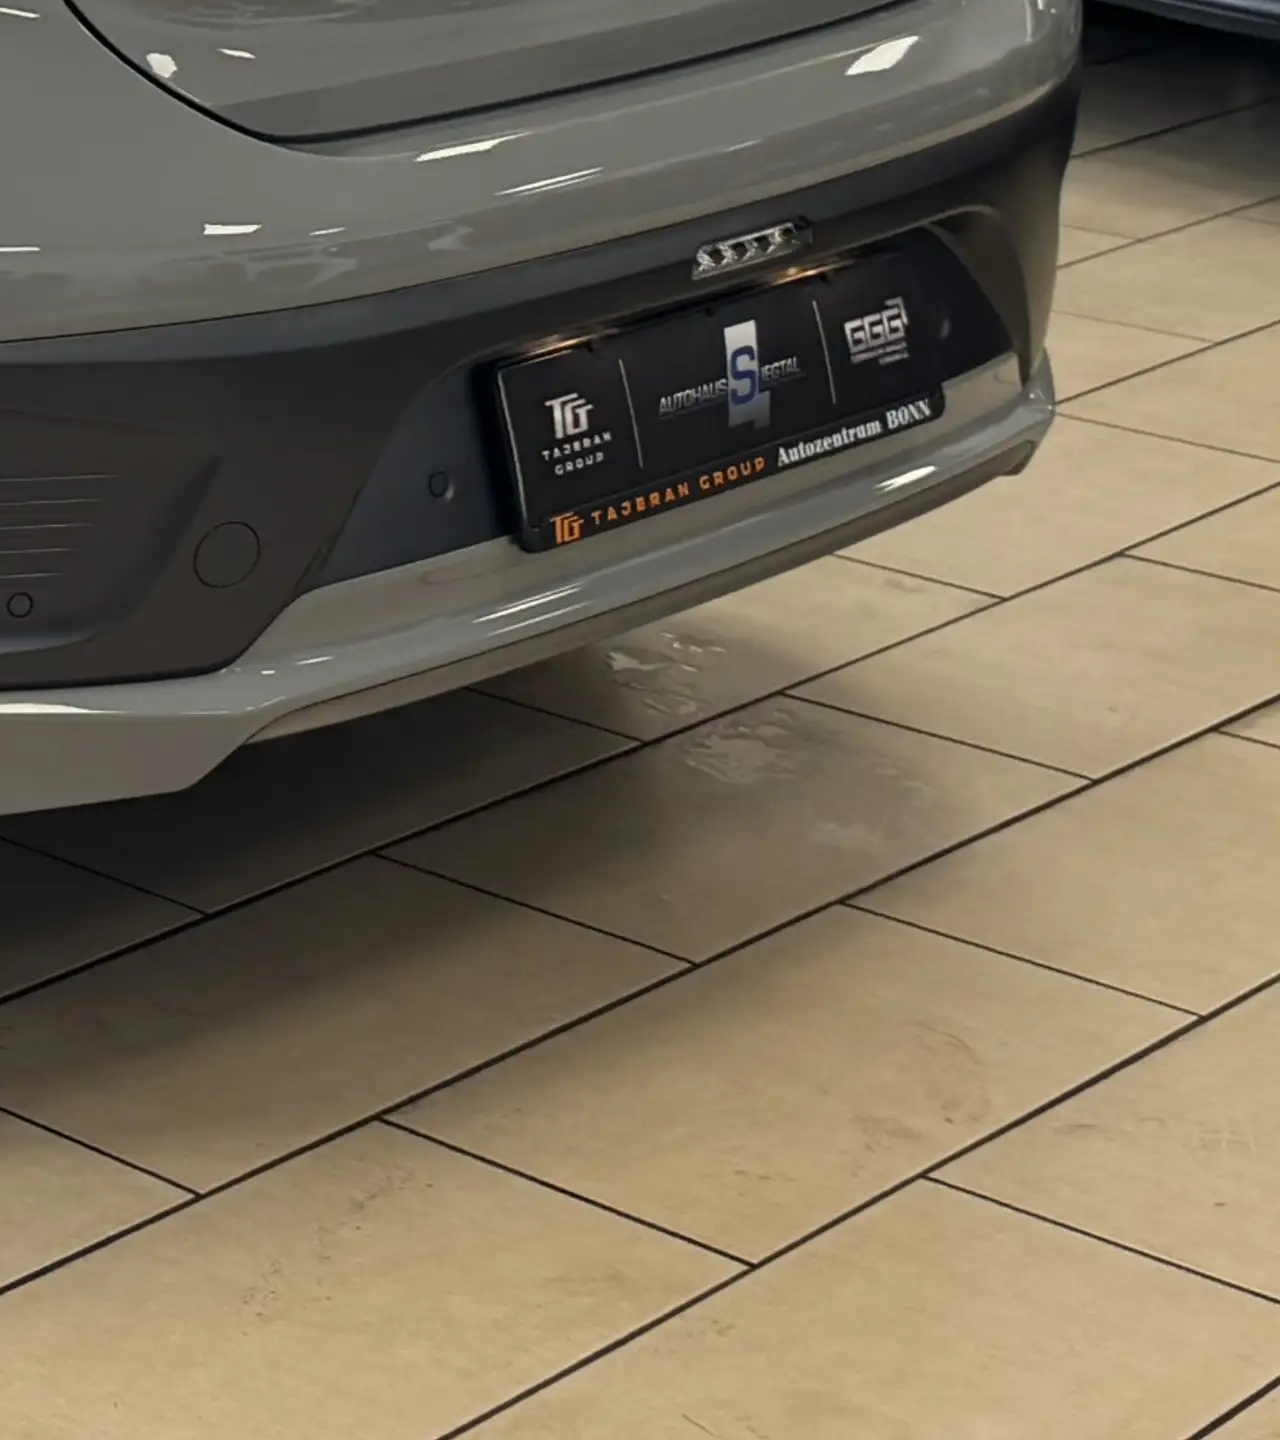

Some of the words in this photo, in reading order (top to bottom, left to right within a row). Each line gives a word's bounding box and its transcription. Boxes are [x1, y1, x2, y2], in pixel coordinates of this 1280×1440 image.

[659, 378, 729, 412] AUTOHAUS
[541, 431, 612, 461] TAJERAN
[591, 482, 690, 526] TAJERAN
[699, 456, 766, 491] GROUP
[777, 419, 883, 467] Autozentrum
[885, 398, 933, 430] BONN
[554, 452, 605, 476] GROUP
